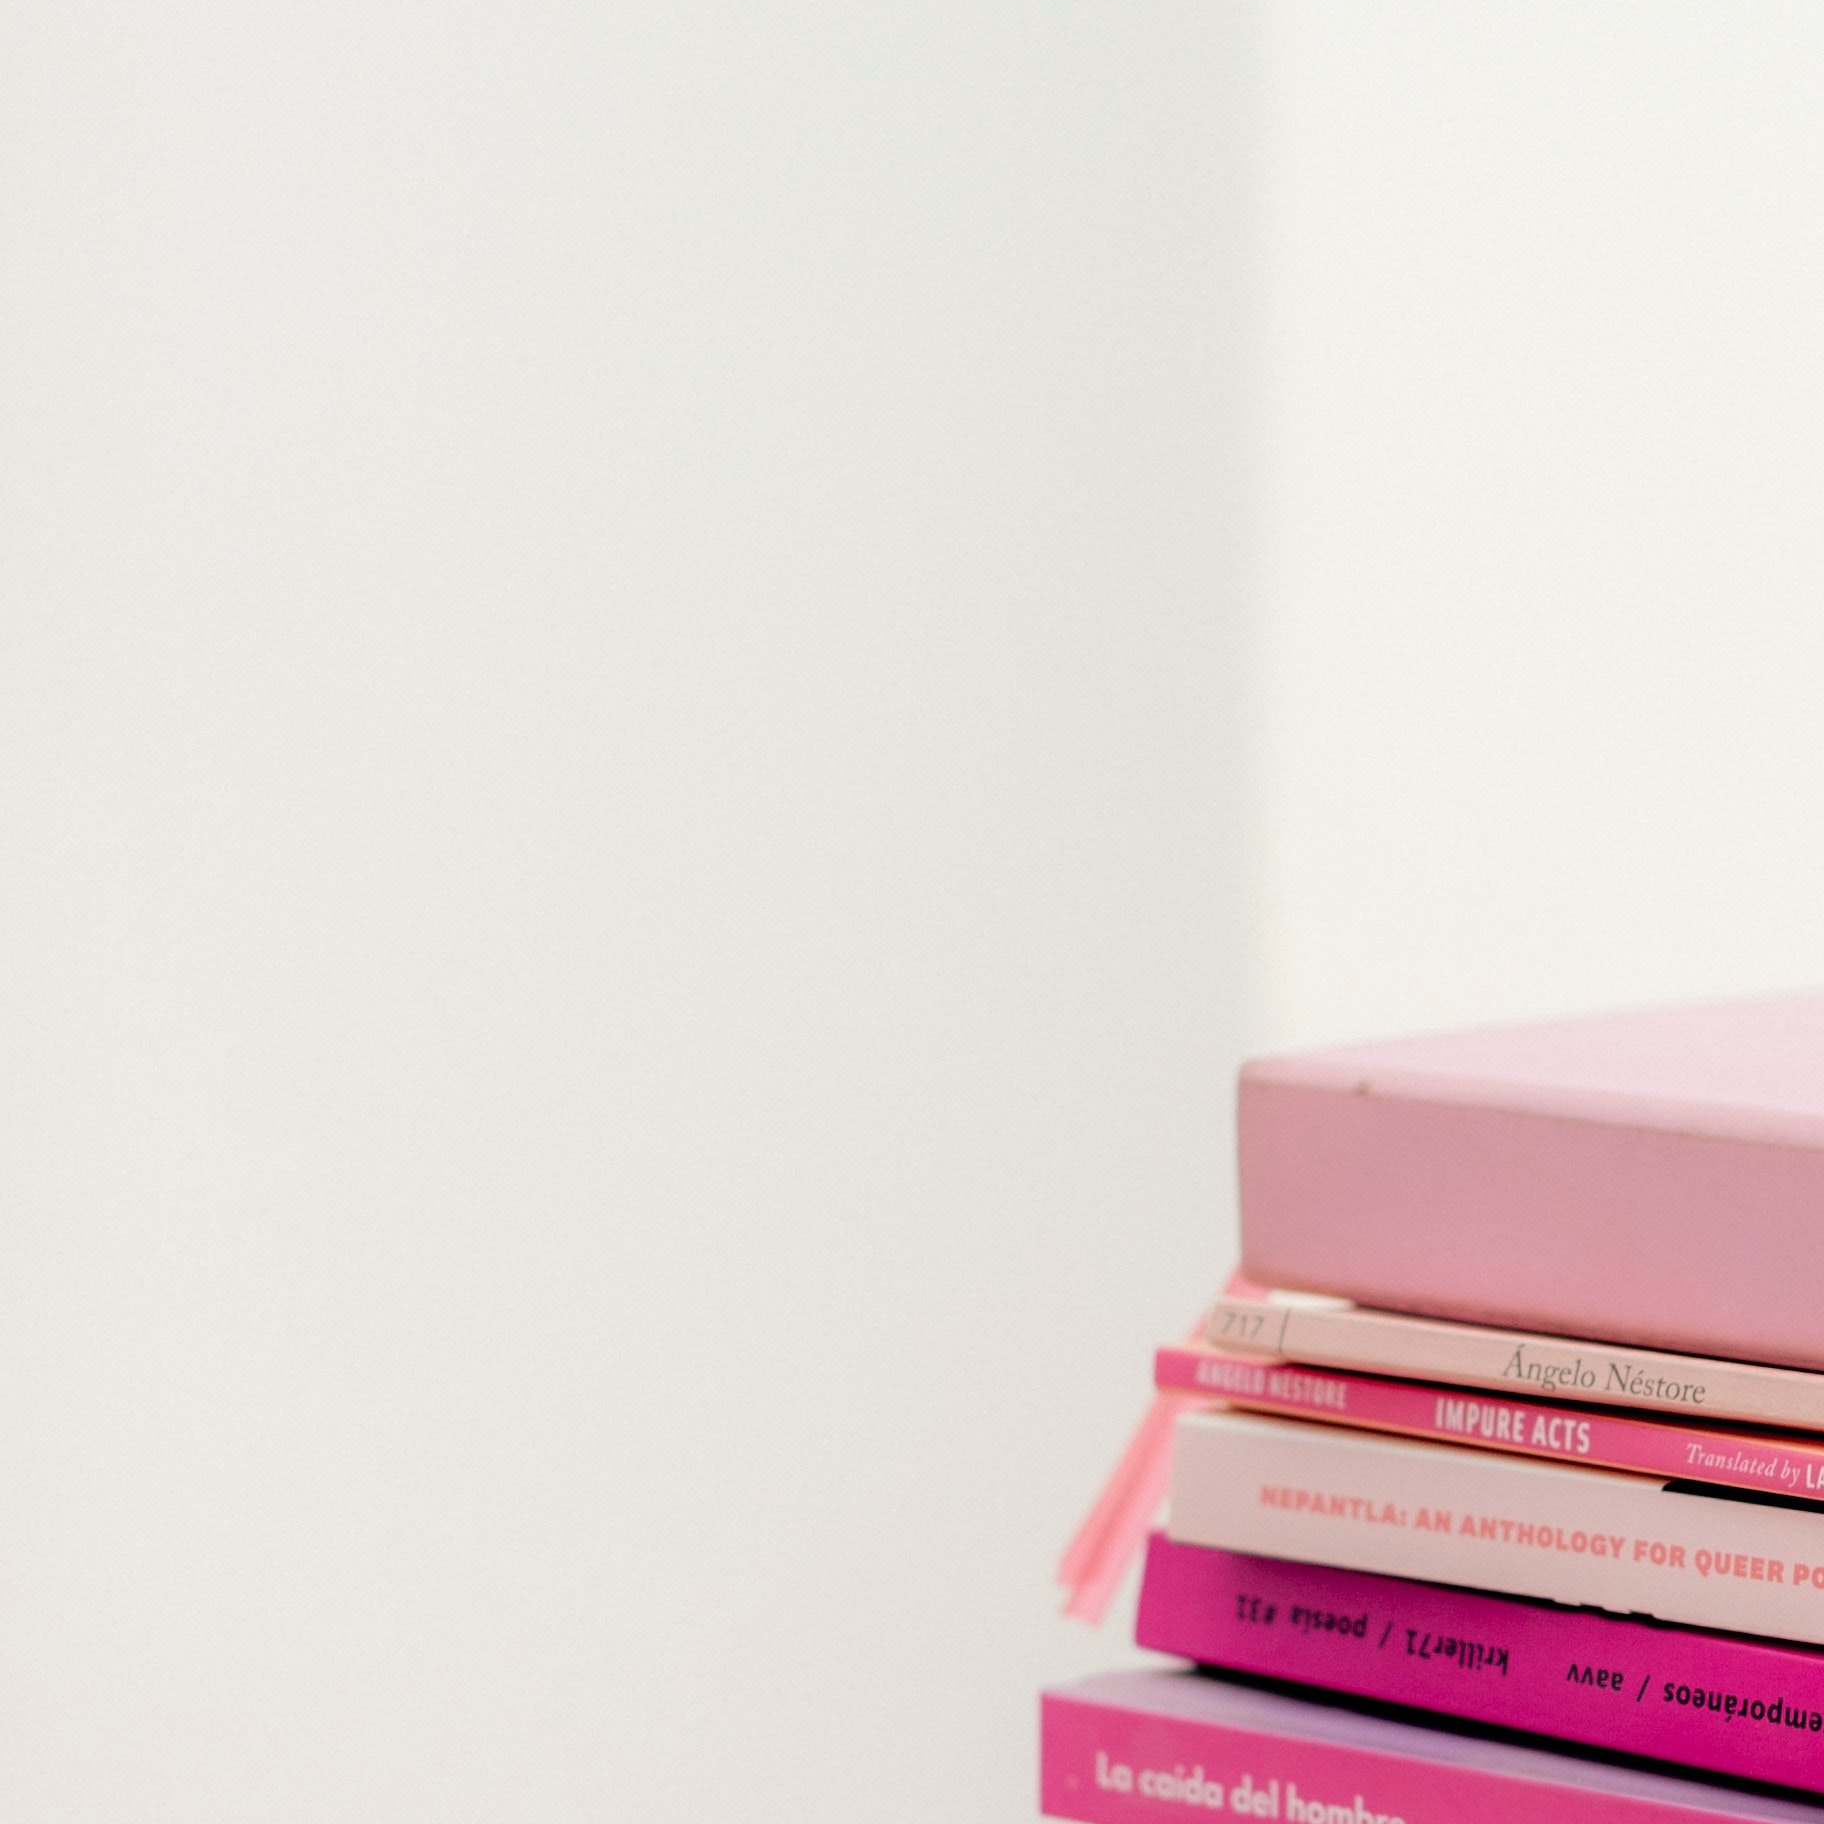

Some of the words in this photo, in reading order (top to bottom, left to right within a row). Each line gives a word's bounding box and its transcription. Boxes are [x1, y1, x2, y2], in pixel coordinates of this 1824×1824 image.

[1501, 1342, 1596, 1391] Ángelo
[1604, 1362, 1707, 1404] Néstore
[1434, 1397, 1525, 1443] IMPURE
[1531, 1414, 1592, 1455] ACTS
[1686, 1442, 1778, 1478] Translated
[1780, 1464, 1801, 1489] by
[1259, 1484, 1408, 1529] NEPANTLA:
[1415, 1507, 1453, 1534] AN
[1459, 1513, 1626, 1560] ANTHOLOGY
[1633, 1539, 1687, 1569] FOR
[1694, 1549, 1785, 1584] QUEER
[1565, 1661, 1625, 1693] aavv
[1095, 1748, 1134, 1793] La
[1230, 1773, 1281, 1819] del
